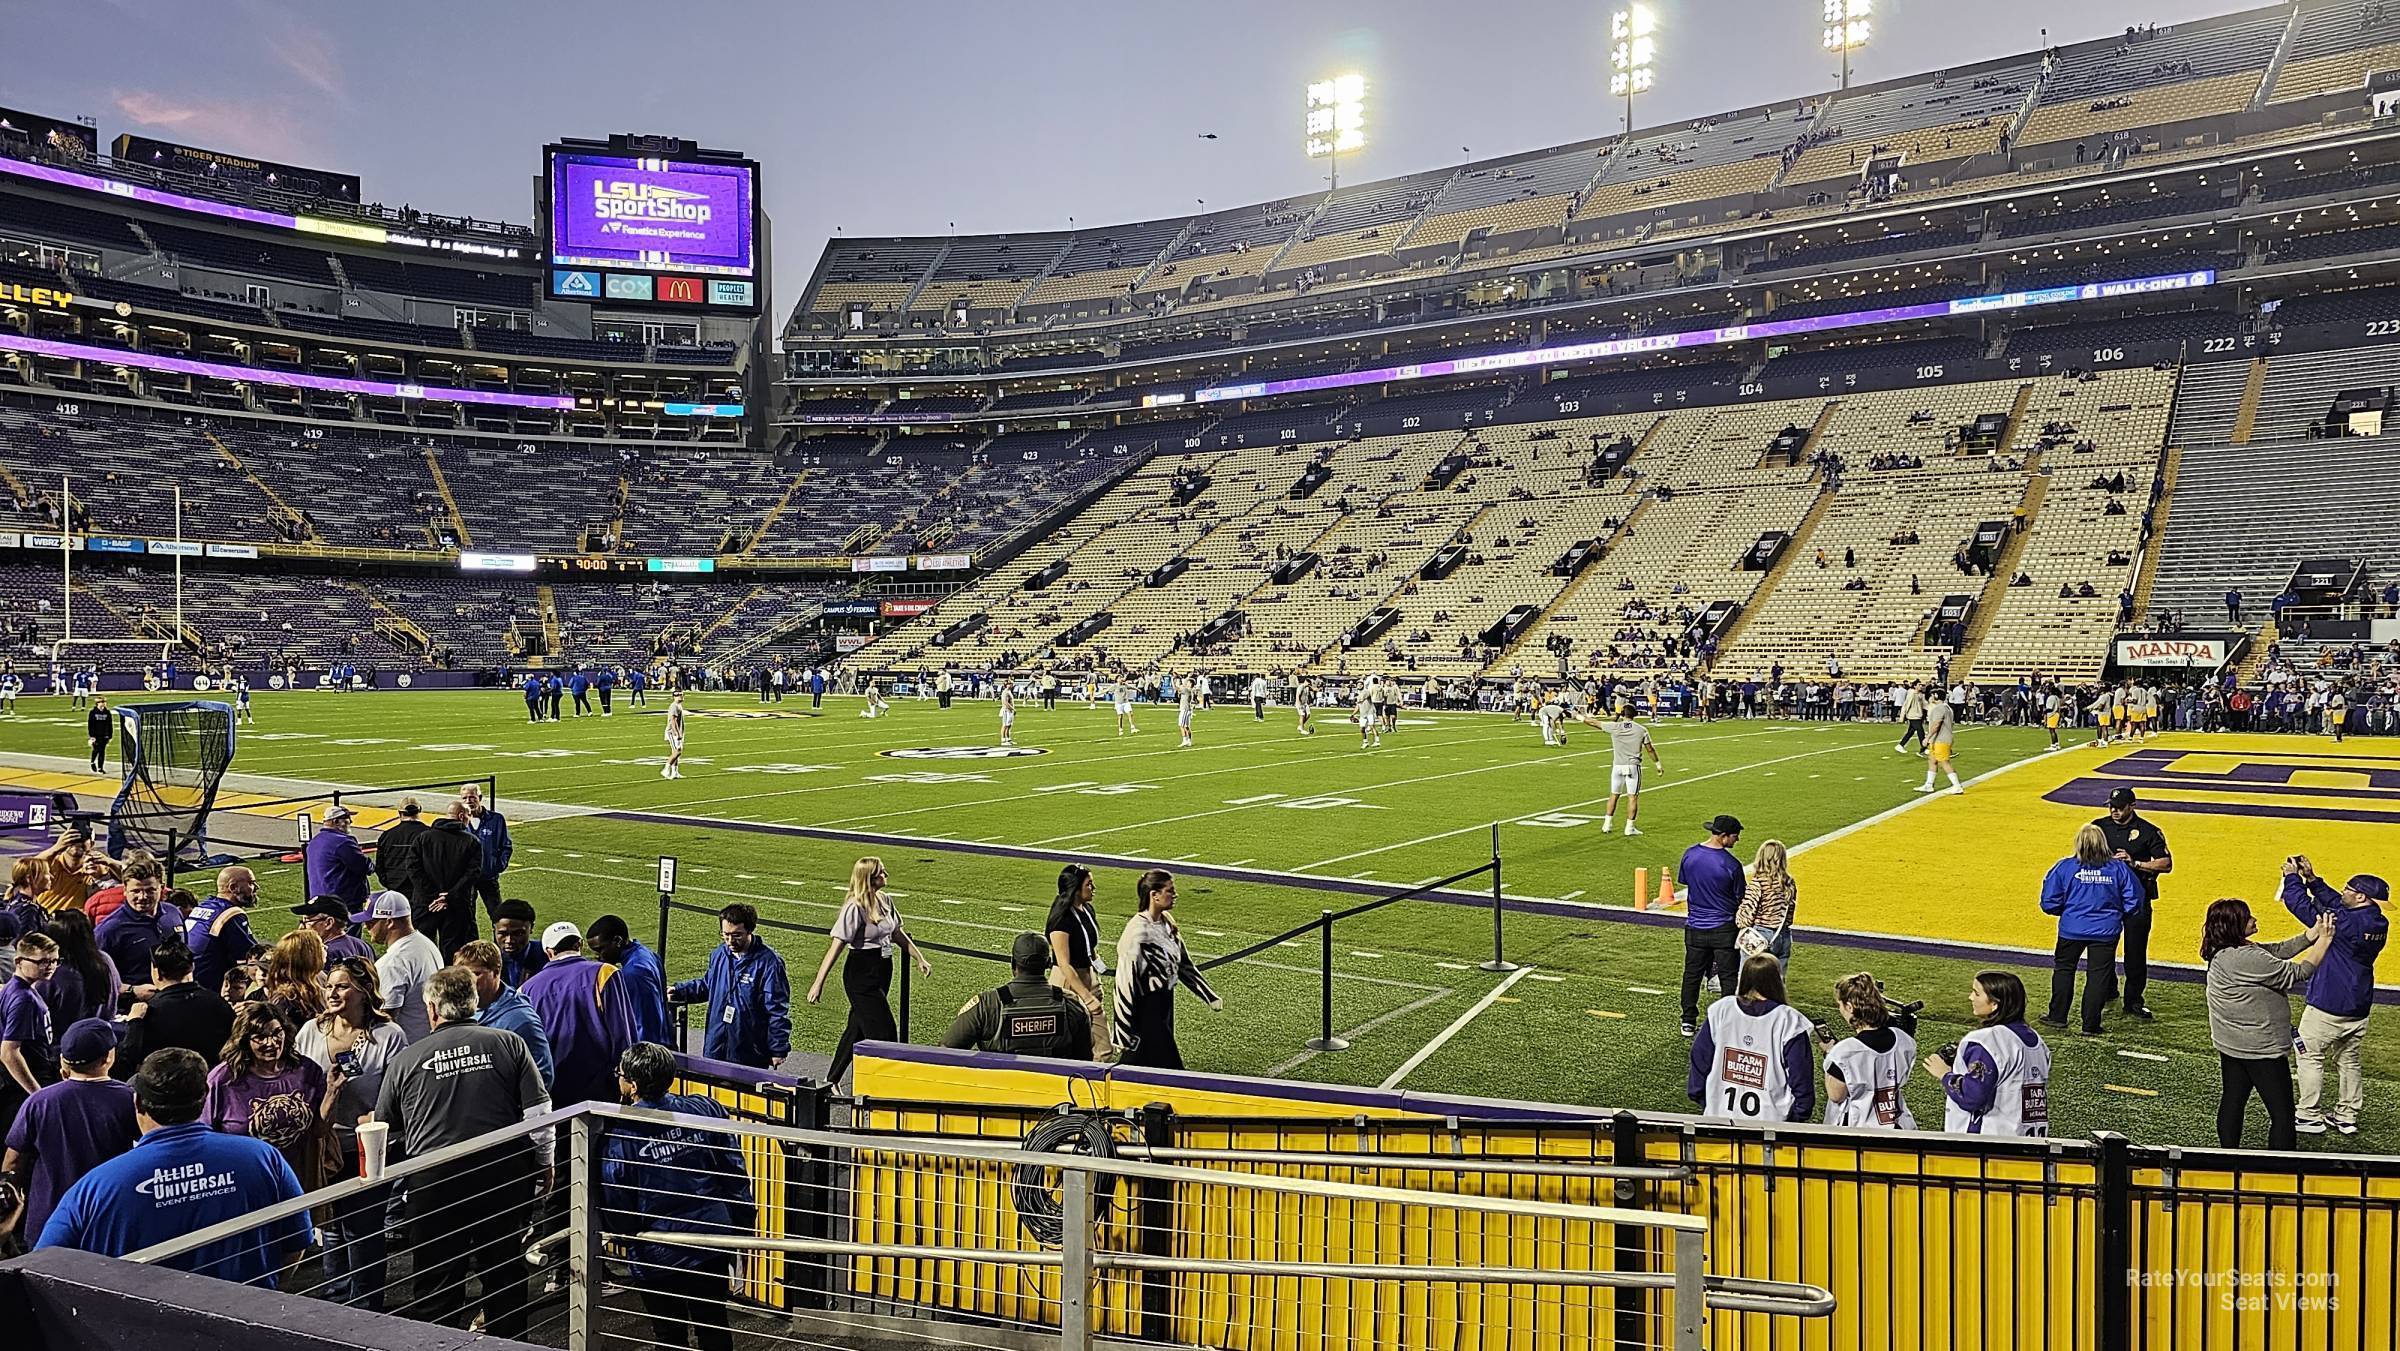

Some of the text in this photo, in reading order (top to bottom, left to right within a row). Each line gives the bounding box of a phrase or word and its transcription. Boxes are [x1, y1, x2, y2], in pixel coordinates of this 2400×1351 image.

[627, 133, 679, 153] LSU
[2114, 132, 2129, 140] 618
[183, 148, 260, 169] TIGER STADIUM
[594, 180, 650, 200] LSU
[595, 197, 711, 224] SportShop
[622, 225, 659, 236] Fanatics
[659, 227, 706, 240] Experience
[561, 287, 592, 296] Albertsons
[608, 278, 650, 294] COX
[717, 283, 745, 293] PEOPLES
[2101, 276, 2187, 296] WALK-ON'S
[1715, 326, 1748, 342] LSU
[2366, 320, 2400, 336] 223
[2203, 337, 2236, 353] 222
[2093, 347, 2124, 362] 106
[1916, 365, 1944, 379] 105
[1739, 383, 1764, 396] 104
[56, 403, 79, 415] 418
[1559, 401, 1580, 413] 103
[1402, 417, 1421, 428] 102
[303, 429, 323, 439] 419
[1280, 429, 1297, 439] 101
[1112, 444, 1128, 454] 424
[1184, 438, 1201, 448] 100
[1022, 451, 1038, 460] 423
[33, 537, 60, 547] WBRZ
[576, 559, 607, 570] 90:00
[853, 605, 876, 613] FEDERAL
[2126, 642, 2214, 660] MANDA
[1223, 794, 1362, 810] 10
[554, 924, 571, 933] LSU
[1014, 1019, 1054, 1033] SHERIFF
[434, 1046, 471, 1062] ALLIED
[1737, 1053, 1764, 1068] FARM
[434, 1053, 492, 1074] UNIVERSAL
[1727, 1060, 1764, 1077] BUREAU
[435, 1064, 494, 1080] EVENT SERVICES
[1732, 1073, 1762, 1086] INSURANCE
[1724, 1086, 1761, 1117] 10
[153, 1163, 204, 1184] ALLIED
[154, 1172, 235, 1200] UNIVERSAL
[155, 1186, 237, 1208] EVENT SERVICES
